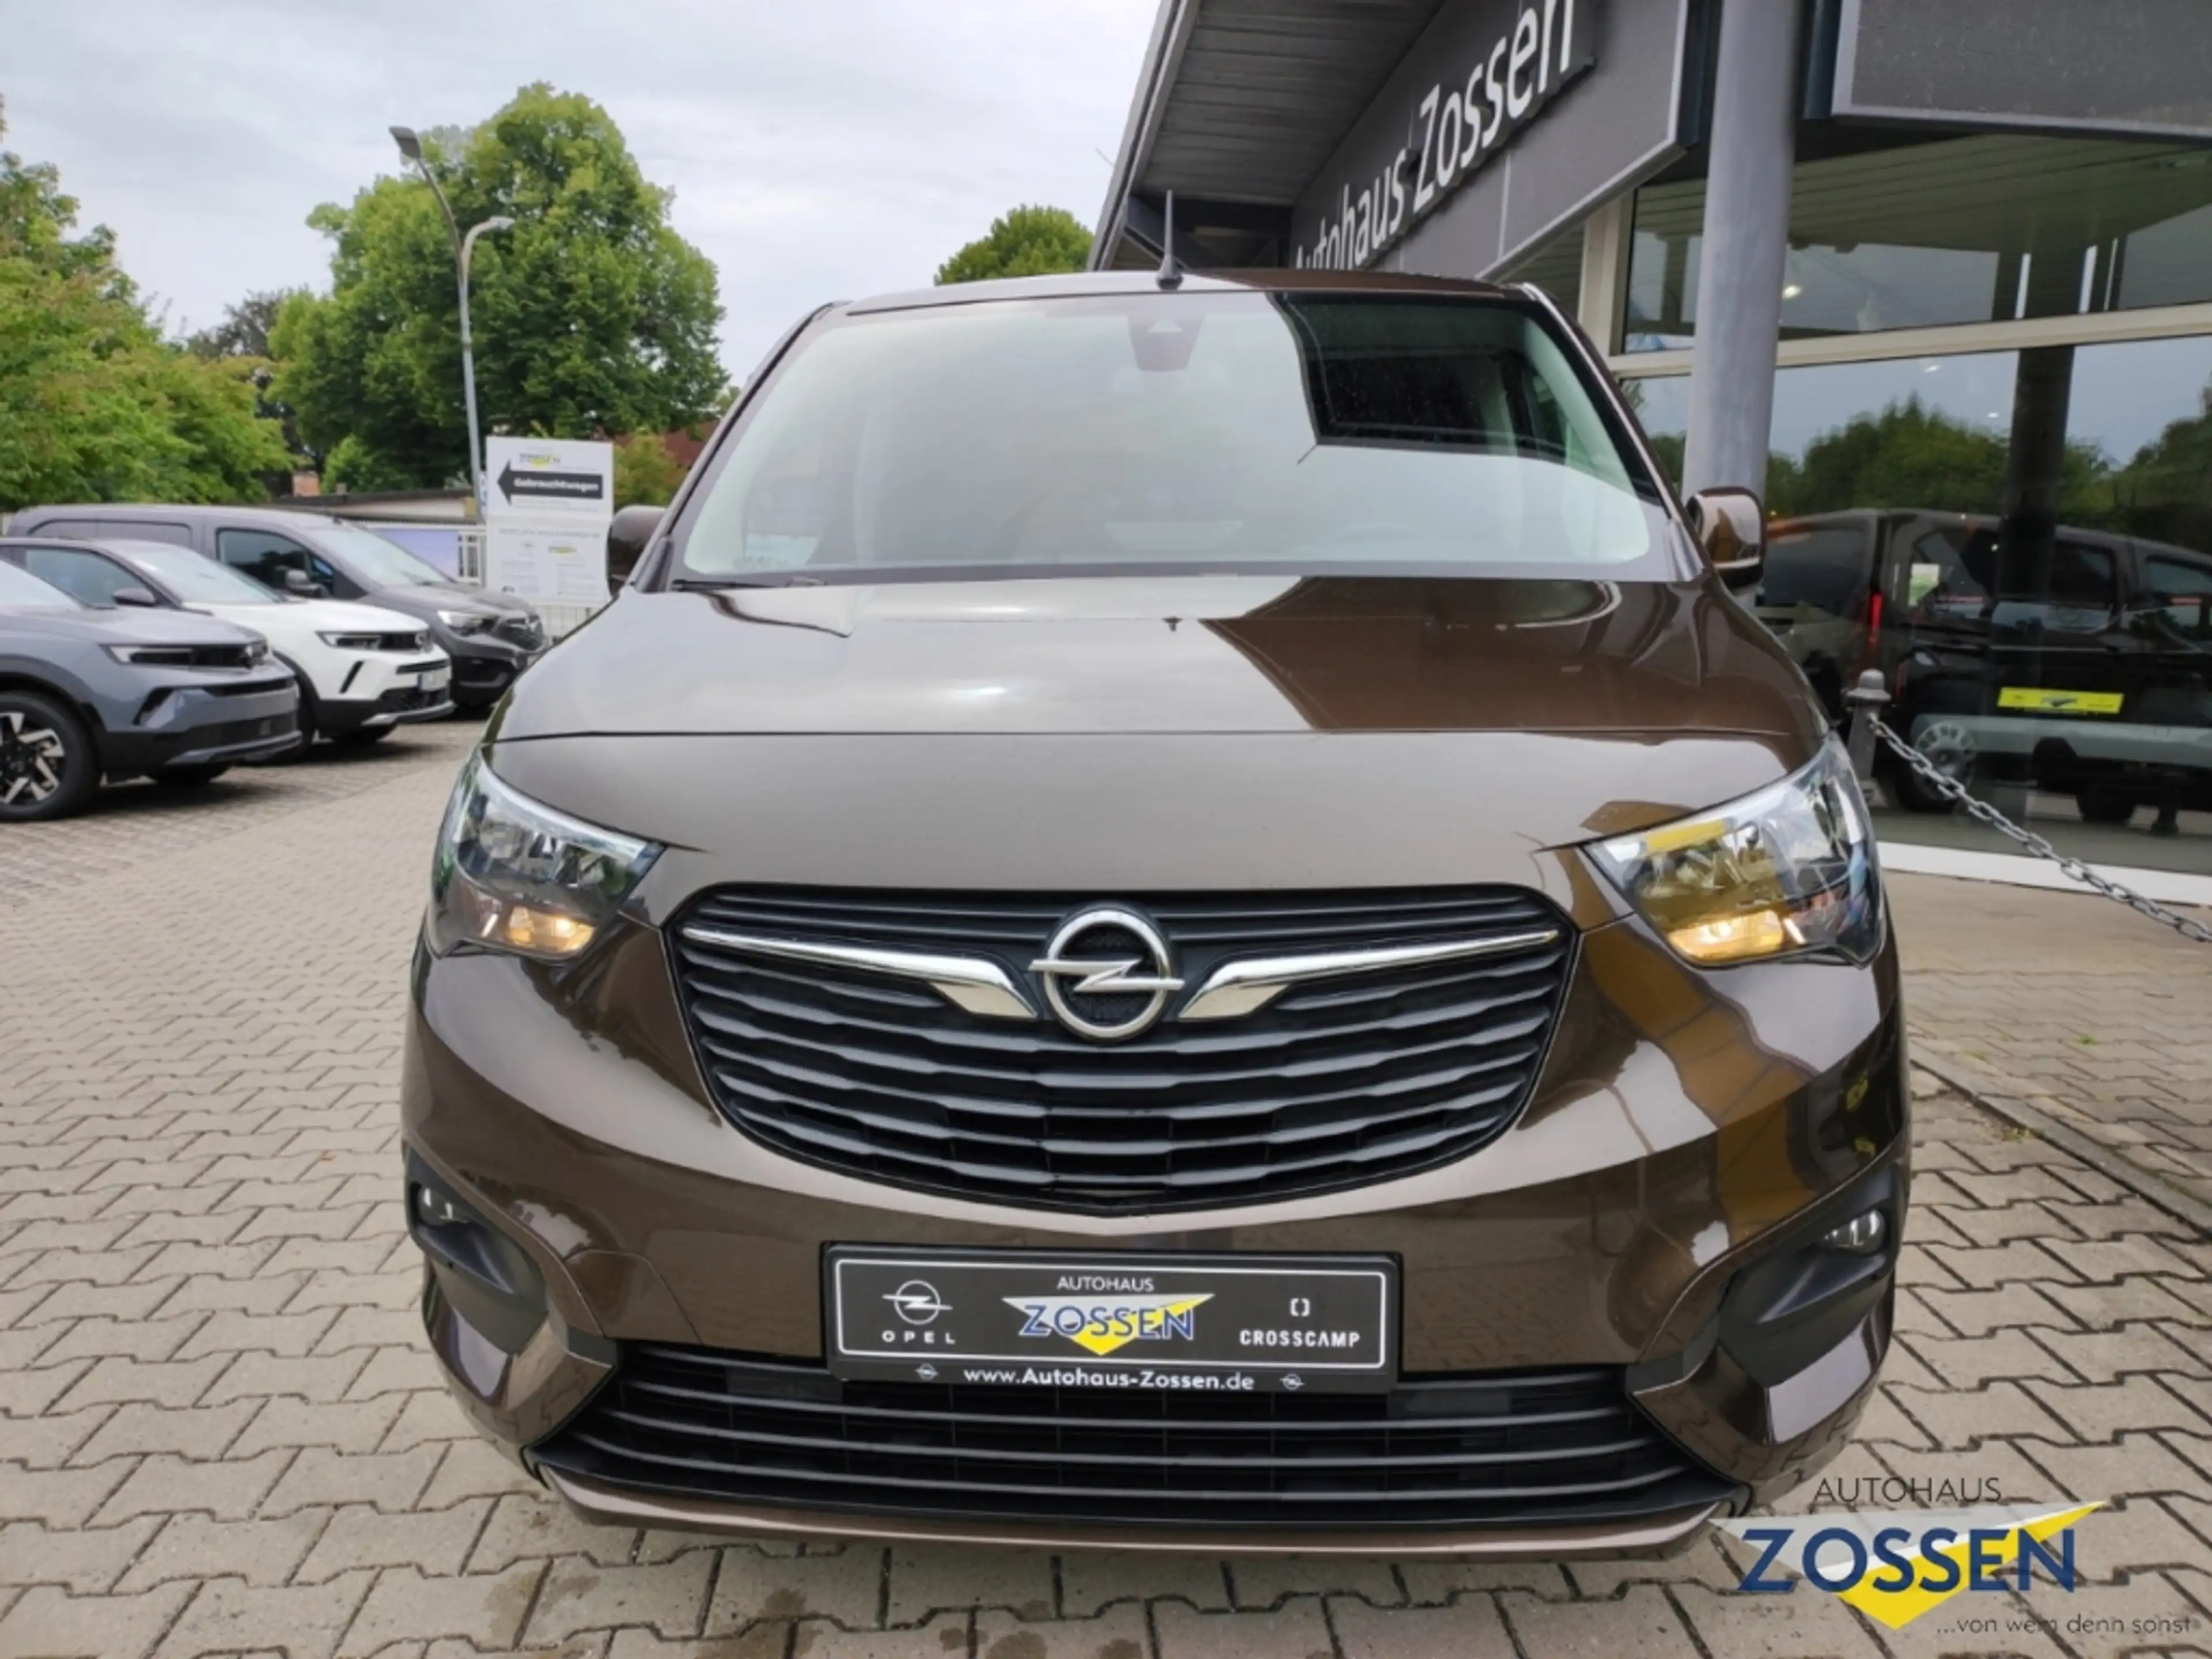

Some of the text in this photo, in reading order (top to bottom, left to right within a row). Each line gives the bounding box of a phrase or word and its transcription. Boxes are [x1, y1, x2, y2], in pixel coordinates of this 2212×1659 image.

[1296, 0, 1573, 270] tohaus Zossen
[1056, 1275, 1154, 1292] AUTOHAUS
[1018, 1304, 1194, 1340] ZOSSEN
[881, 1330, 956, 1344] OPEL
[1240, 1329, 1360, 1347] CROSSCAMP
[963, 1367, 1254, 1390] www.Autohaus-Zossen.de
